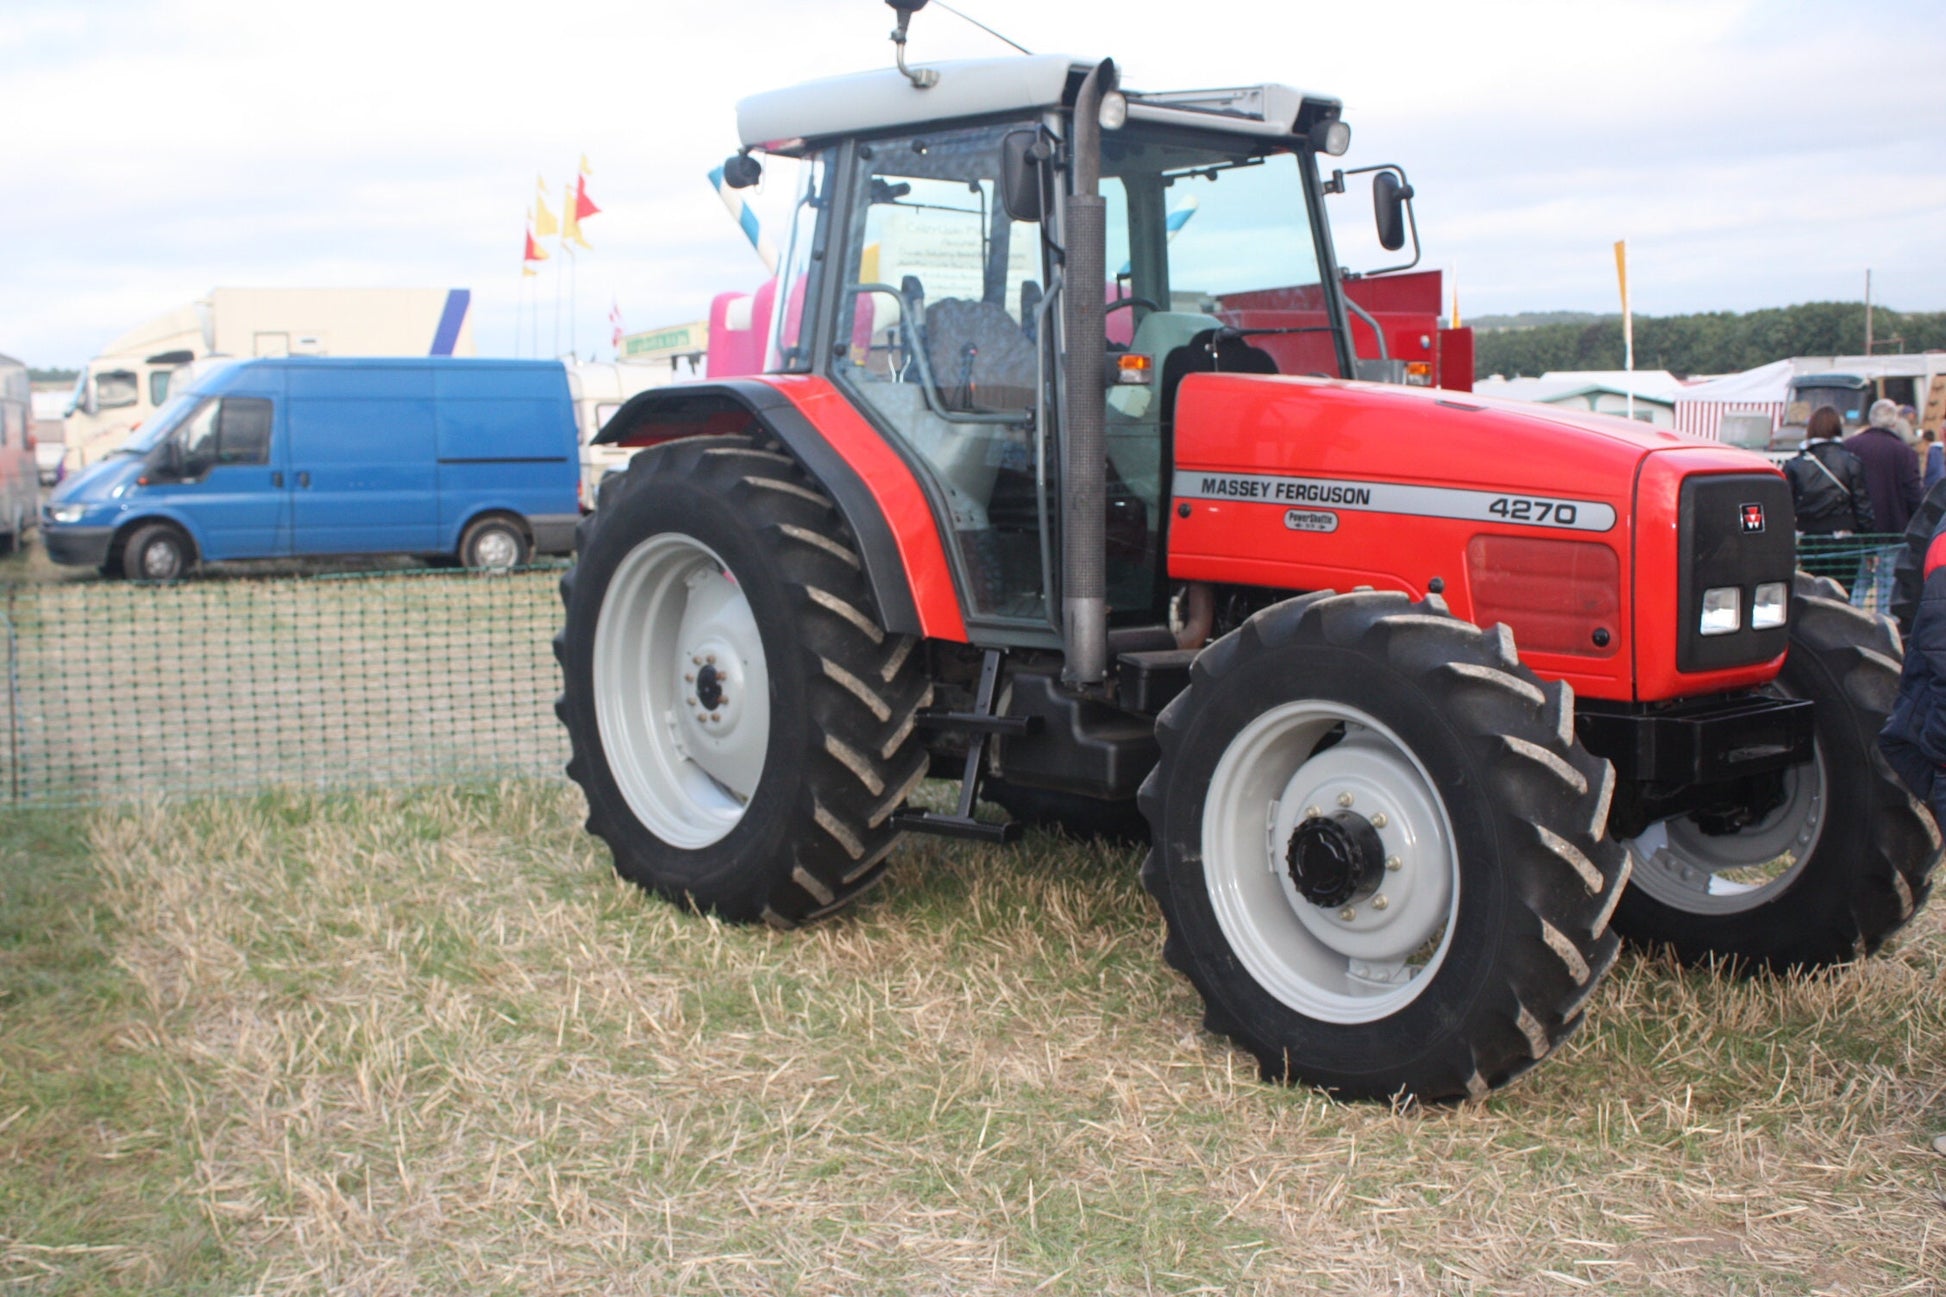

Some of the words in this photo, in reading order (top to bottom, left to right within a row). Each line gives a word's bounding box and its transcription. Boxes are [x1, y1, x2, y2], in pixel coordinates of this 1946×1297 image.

[1201, 478, 1271, 497] MASSEY
[1275, 483, 1371, 505] FERGUSON
[1489, 498, 1577, 524] 4270
